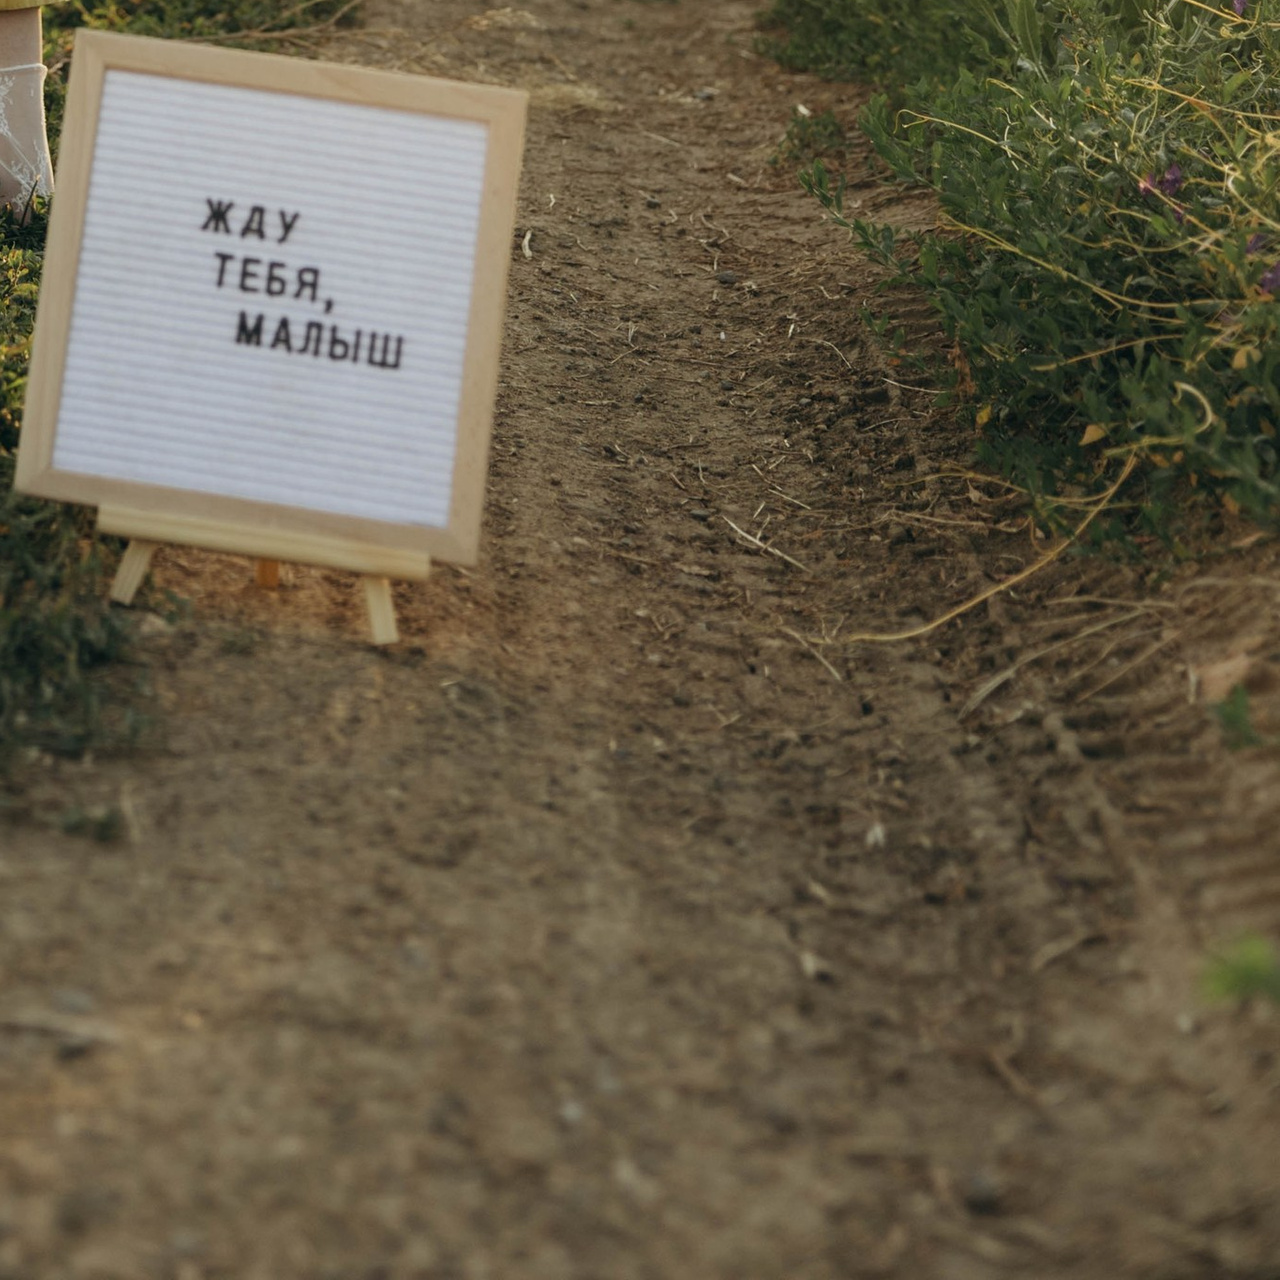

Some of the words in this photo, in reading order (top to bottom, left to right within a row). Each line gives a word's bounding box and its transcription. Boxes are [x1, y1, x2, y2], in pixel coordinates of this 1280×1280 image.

[200, 198, 300, 244] ЖДУ
[214, 252, 334, 315] ТЕБЯ,
[234, 310, 404, 370] МАЛЫШ
